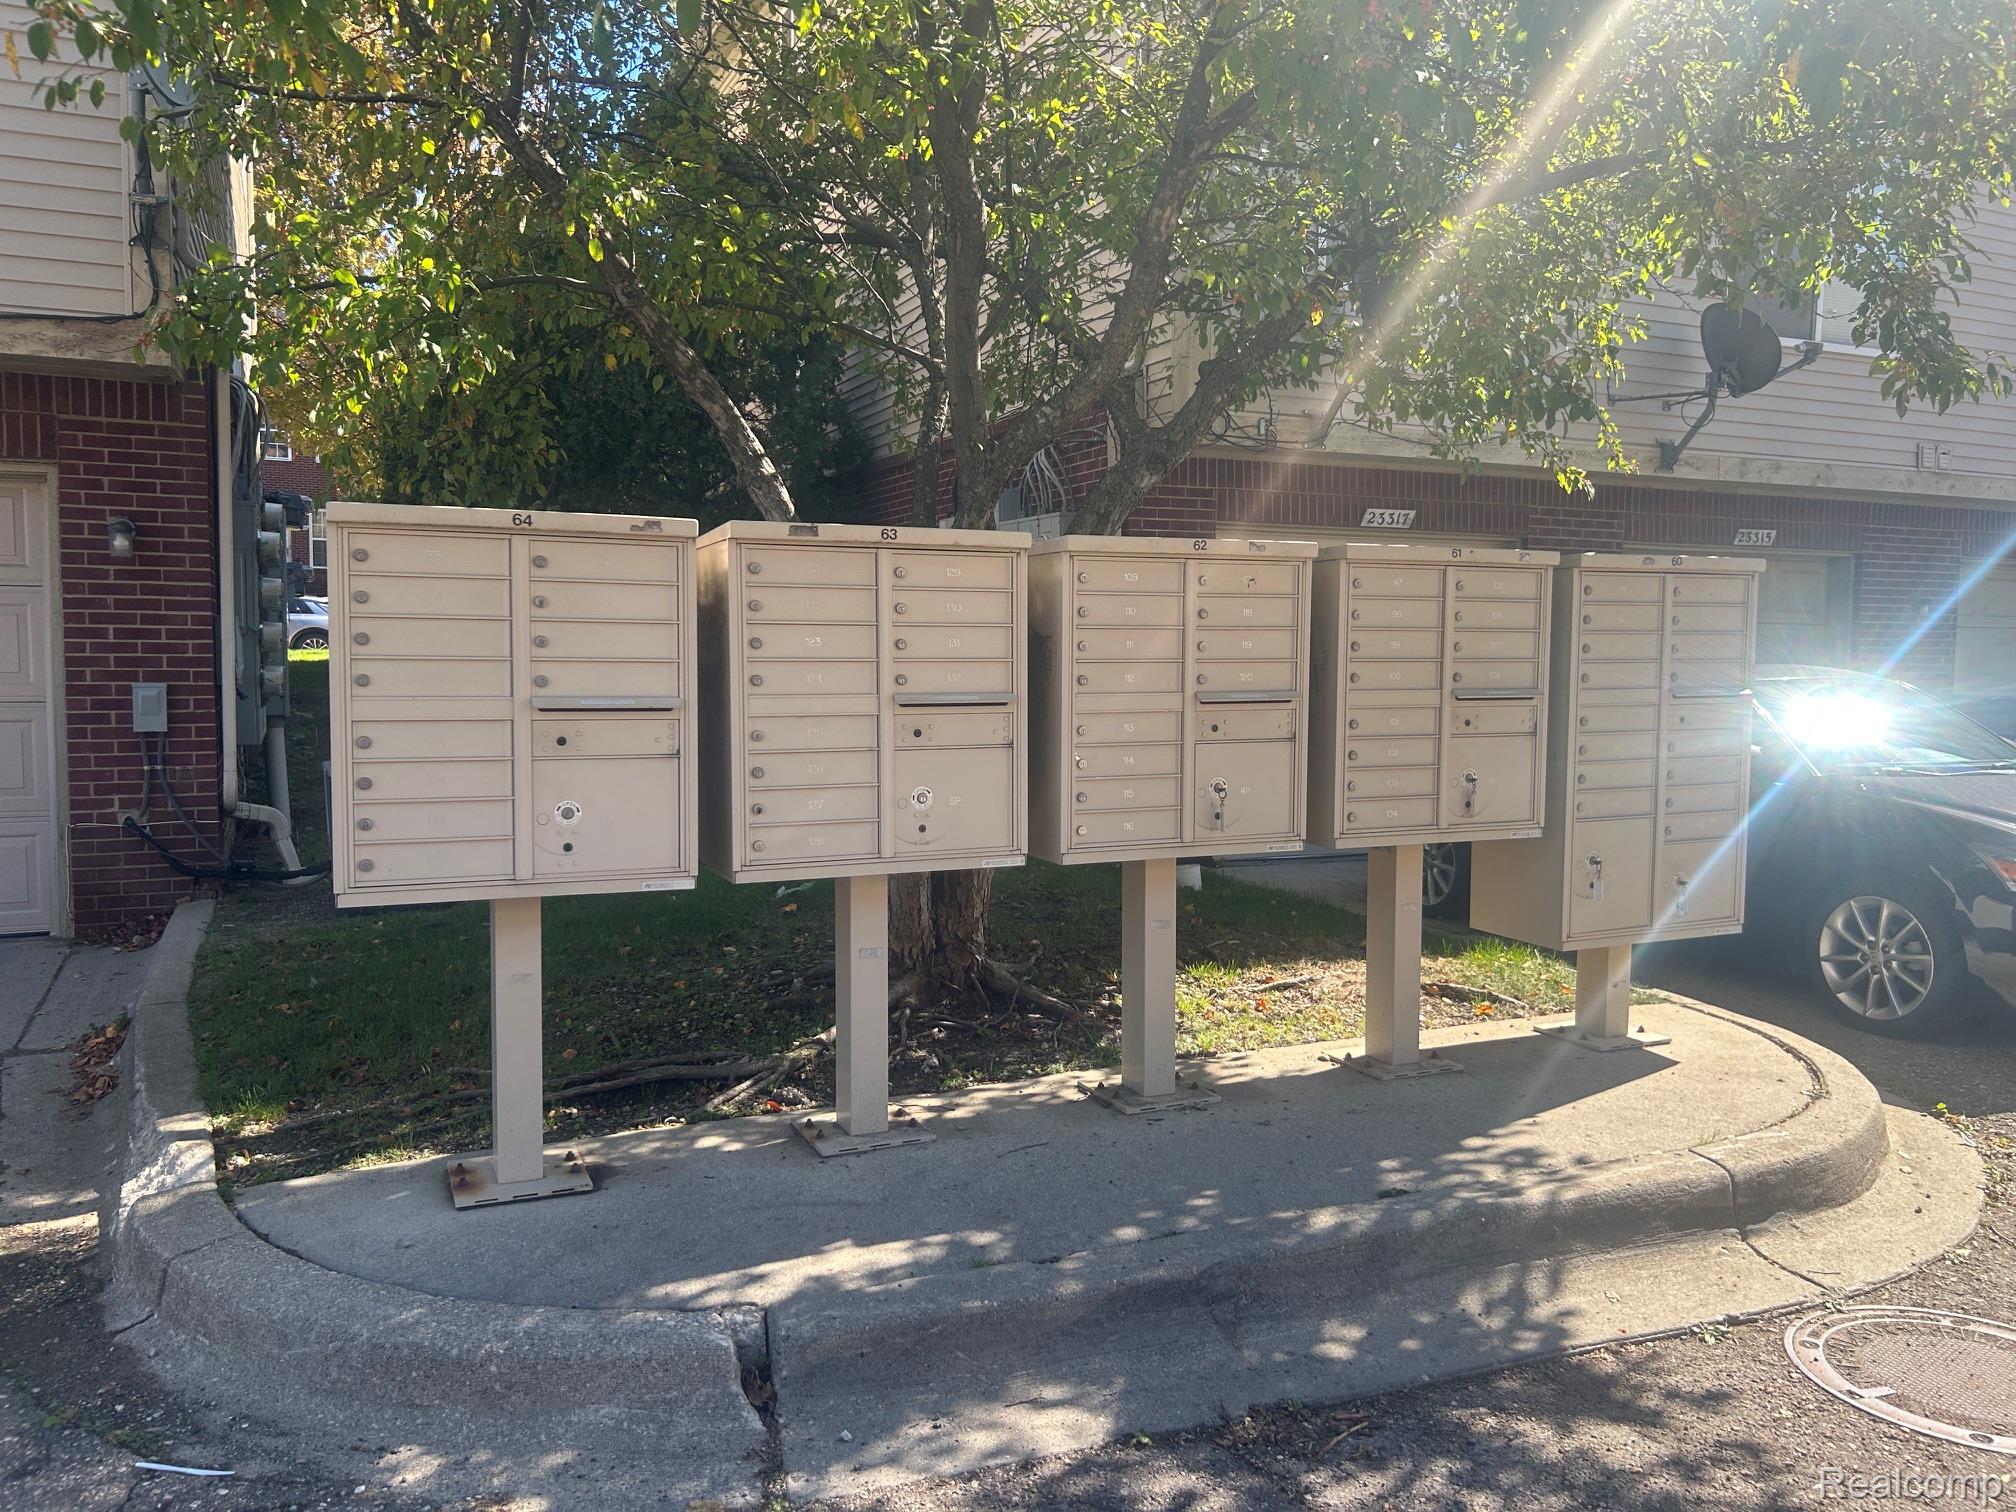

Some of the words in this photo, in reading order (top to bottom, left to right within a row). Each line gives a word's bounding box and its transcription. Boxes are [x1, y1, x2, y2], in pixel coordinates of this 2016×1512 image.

[512, 513, 533, 527] 64
[1367, 512, 1411, 526] 23317
[881, 528, 898, 540] 63
[1193, 540, 1207, 551] 62
[1451, 548, 1462, 558] 61
[1671, 557, 1682, 566] 60
[1123, 572, 1138, 582] 109
[1124, 607, 1136, 616] 110
[1242, 608, 1253, 617] 118
[1126, 640, 1135, 648] 111
[1242, 640, 1252, 648] 119
[1124, 672, 1136, 682] 112
[1240, 671, 1253, 681] 120
[1124, 723, 1136, 733] 113
[1123, 754, 1135, 764] 114
[1123, 788, 1135, 798] 115
[1121, 821, 1134, 831] 116
